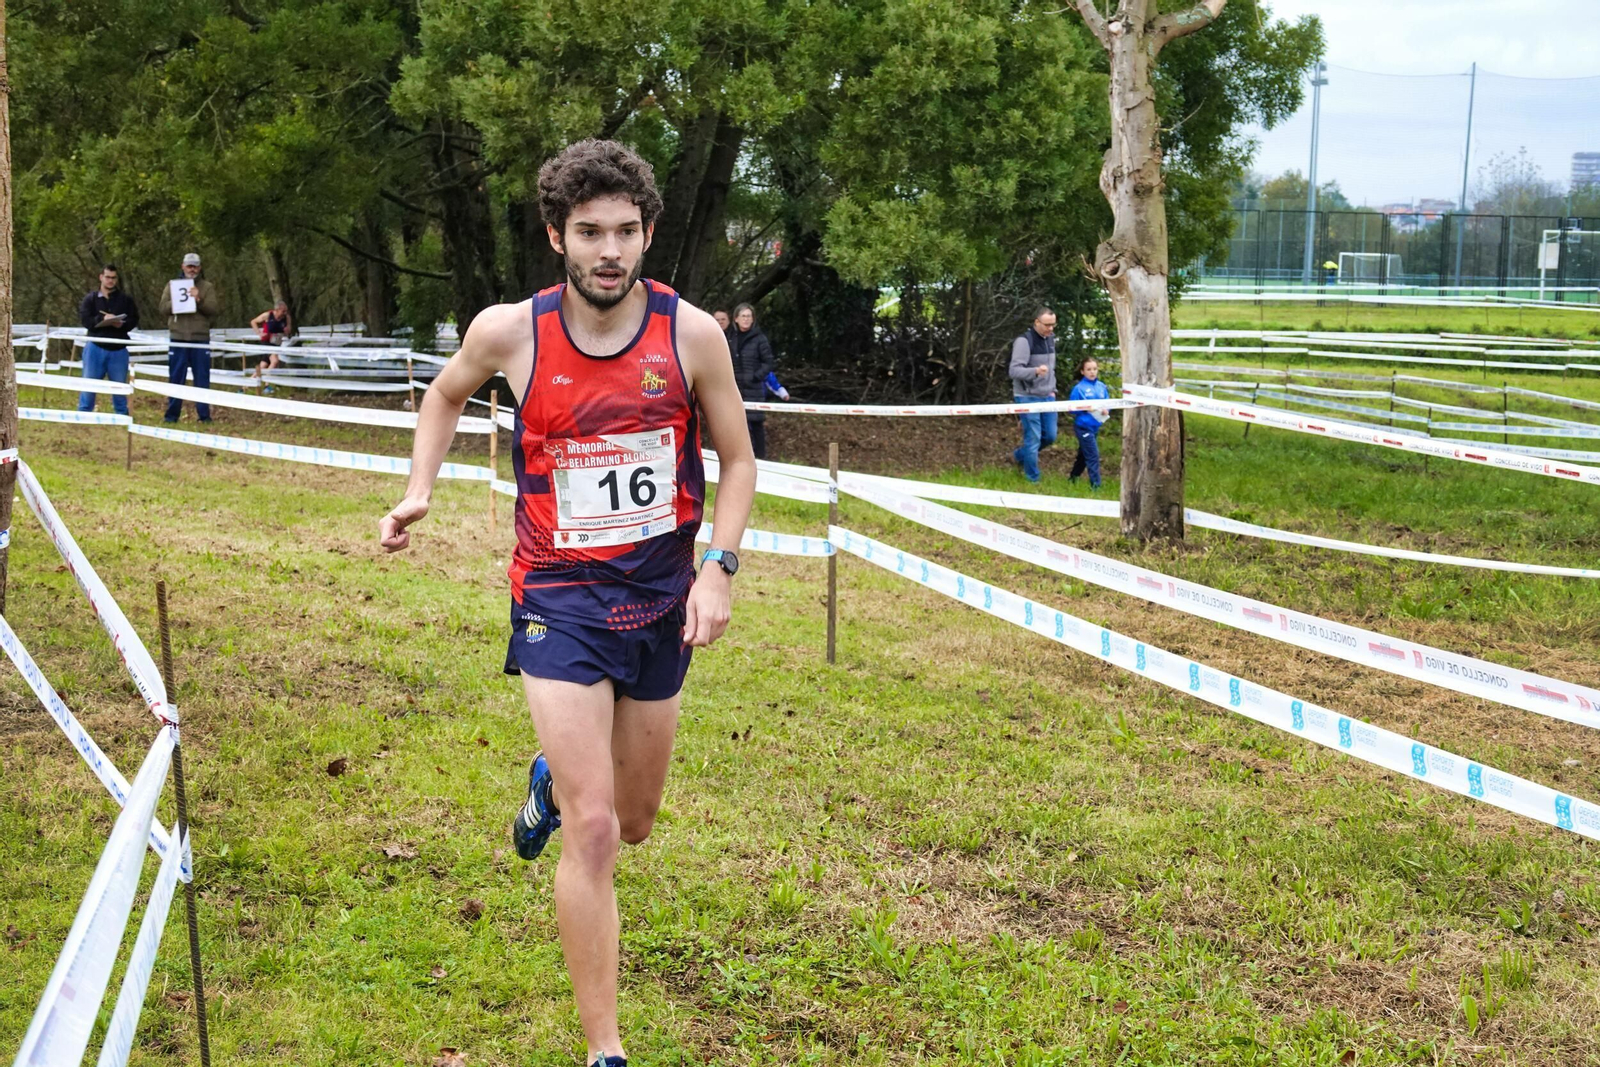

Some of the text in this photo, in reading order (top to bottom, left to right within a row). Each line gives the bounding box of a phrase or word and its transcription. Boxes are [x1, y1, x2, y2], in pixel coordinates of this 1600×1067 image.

[178, 287, 189, 303] 3
[567, 442, 617, 454] MEMORIAL
[569, 454, 620, 468] BELARMINO
[623, 451, 657, 463] ALONSO
[1495, 457, 1520, 467] CONCELLO
[1530, 463, 1542, 471] VIGO
[599, 466, 657, 511] 16
[1489, 773, 1514, 790] DEPORTE
[1489, 783, 1513, 798] GALEGO
